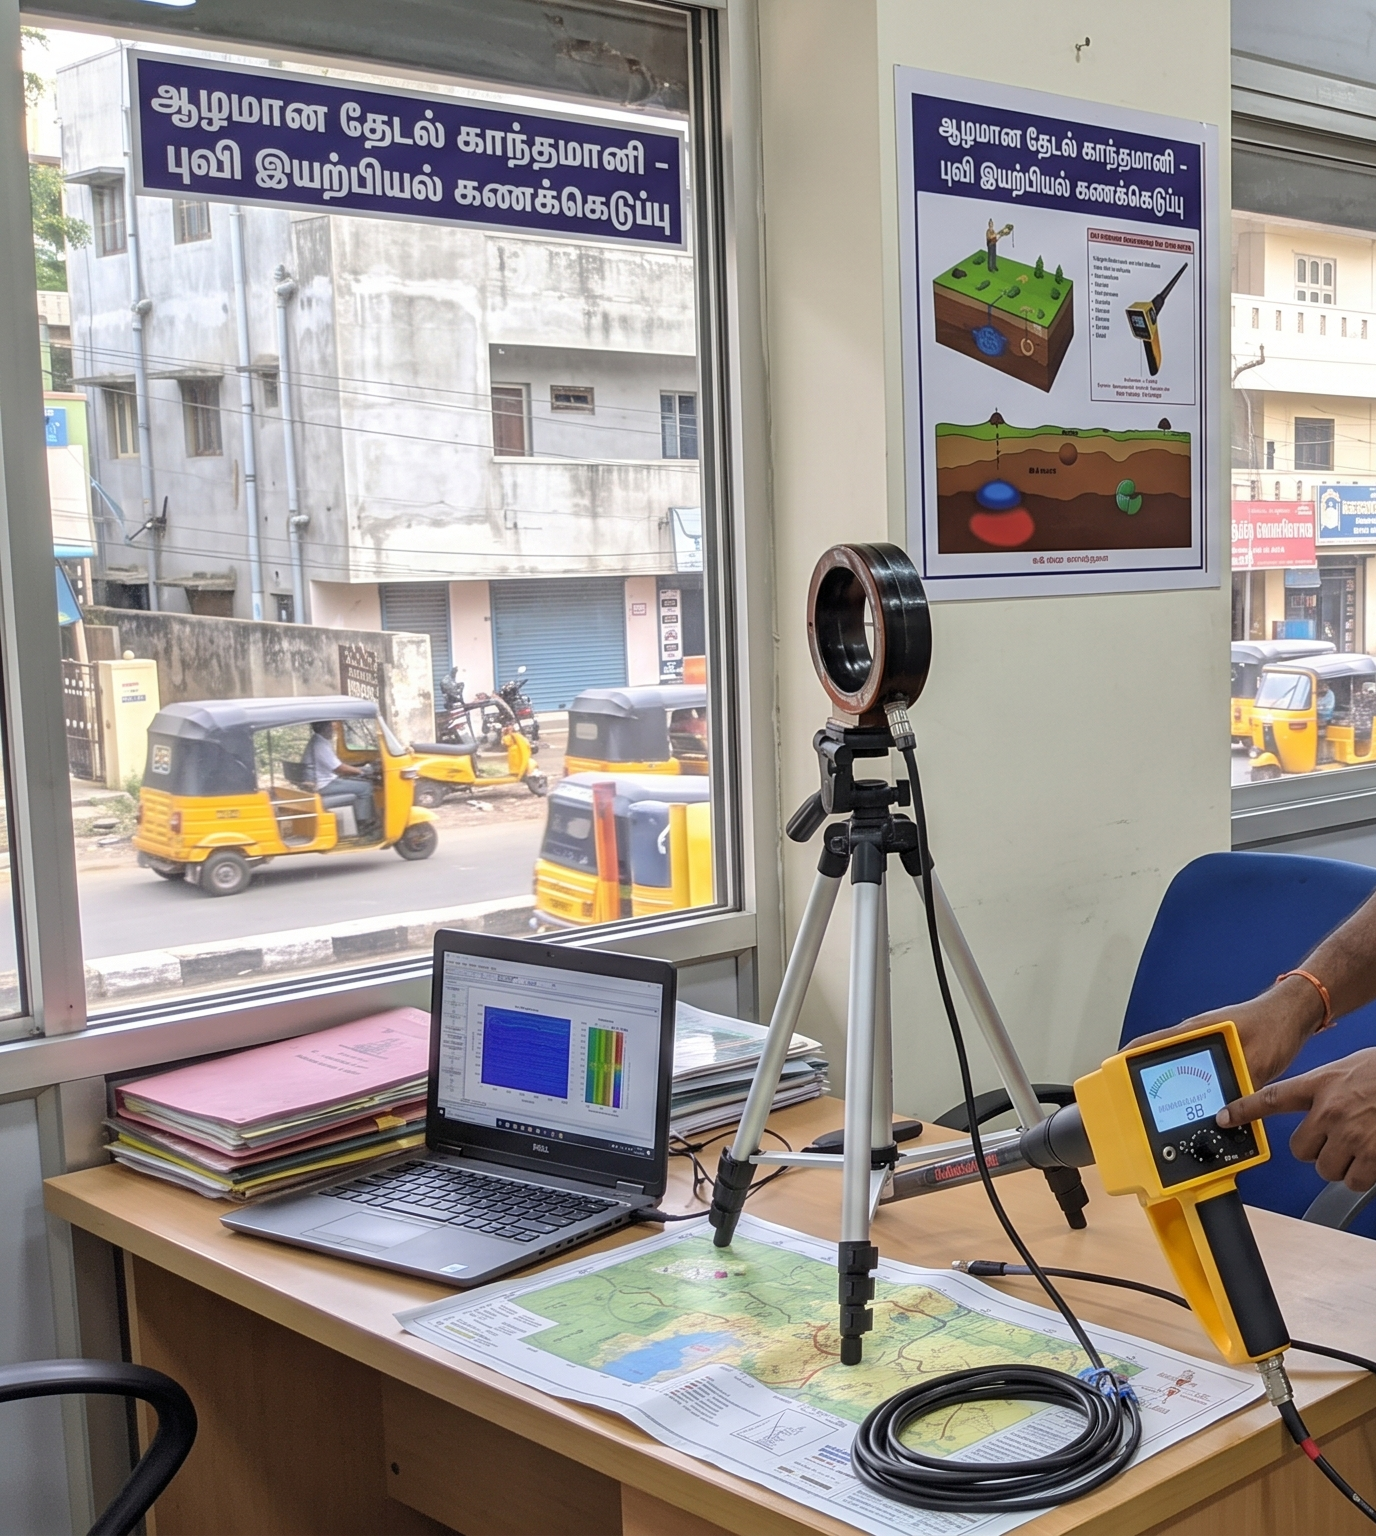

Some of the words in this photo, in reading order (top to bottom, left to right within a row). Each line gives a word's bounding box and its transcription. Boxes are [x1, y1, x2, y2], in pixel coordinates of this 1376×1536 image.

[151, 85, 328, 132] ஆழமான
[340, 102, 445, 149] தேடல்
[456, 122, 645, 175] காந்தமானி
[938, 117, 1022, 149] ஆழமான
[1026, 127, 1078, 160] தேடல்
[1081, 138, 1174, 175] காந்தமானி
[167, 139, 242, 185] புவி
[255, 148, 443, 202] இயற்பியல்
[454, 178, 671, 236] கணக்கெடுப்பு
[940, 155, 975, 187] புவி
[980, 161, 1071, 198] இயற்பியல்
[1075, 179, 1184, 220] கணக்கெடுப்பு
